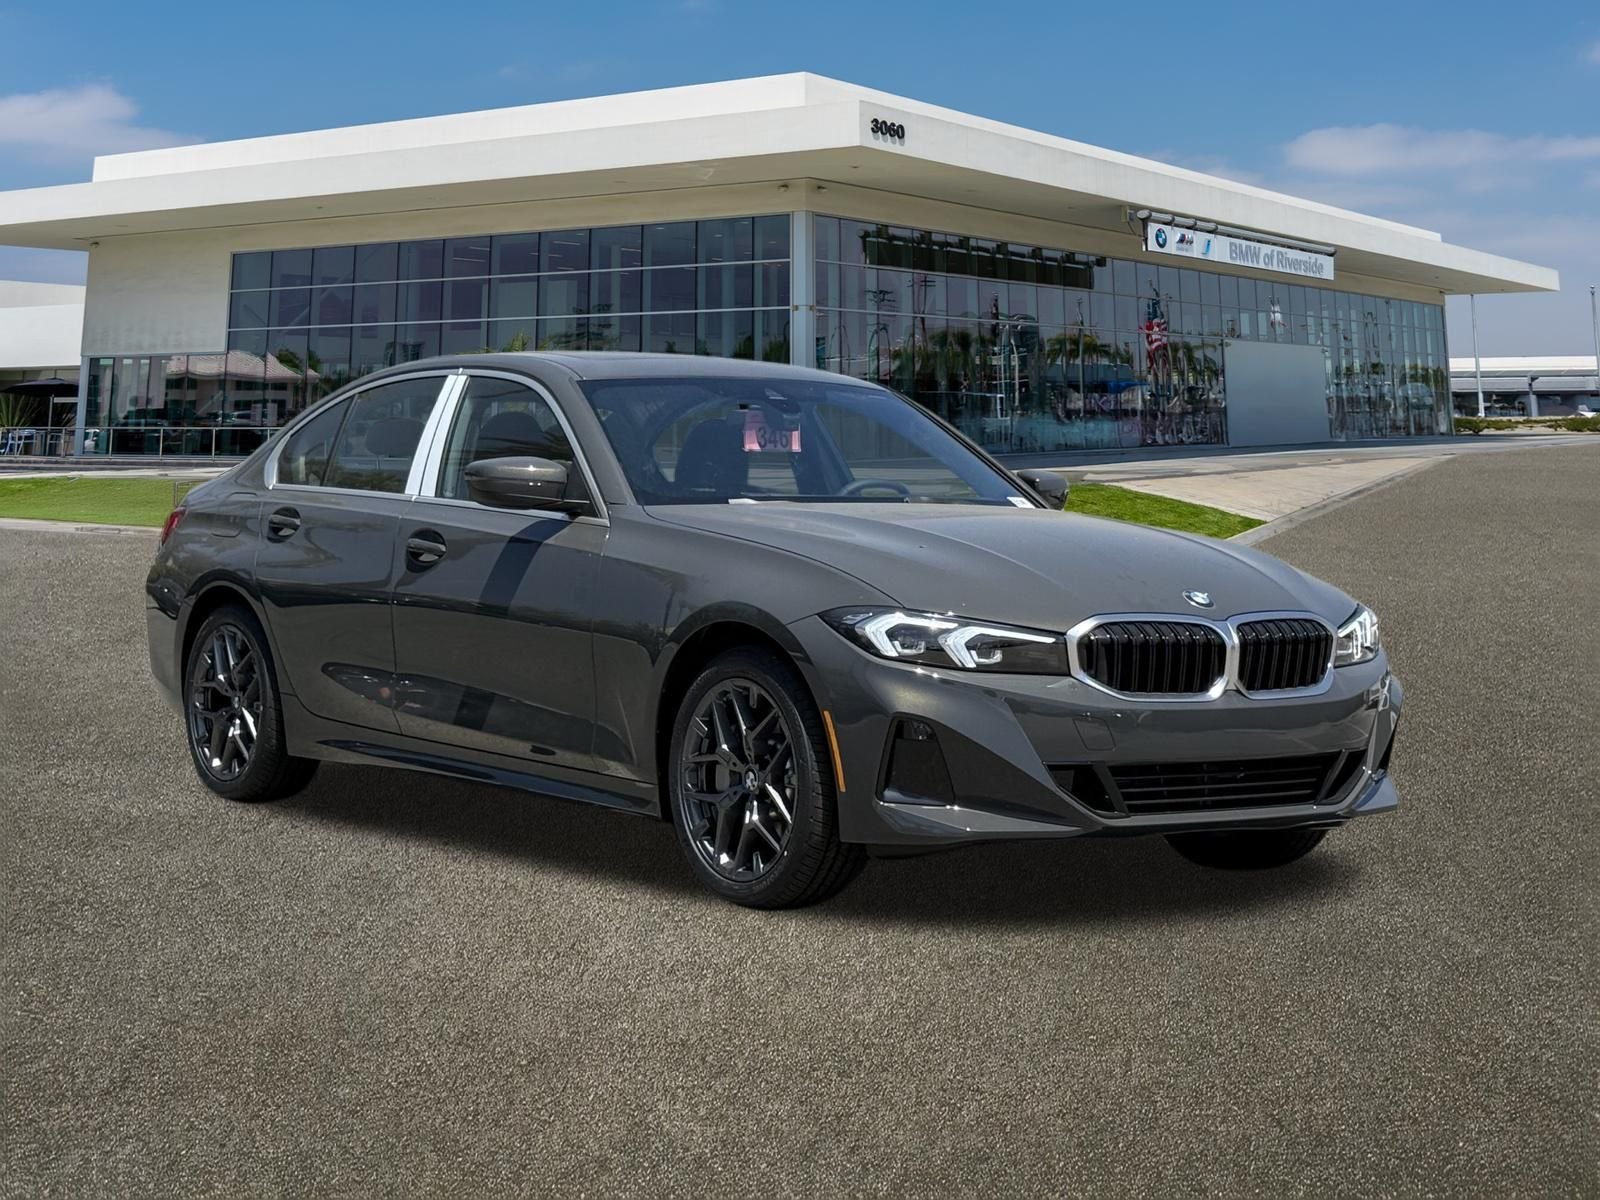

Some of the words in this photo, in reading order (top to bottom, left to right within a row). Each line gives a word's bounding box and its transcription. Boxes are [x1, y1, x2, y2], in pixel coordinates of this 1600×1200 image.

[870, 118, 905, 139] 3060
[1229, 241, 1261, 265] BMW
[1263, 249, 1275, 267] of
[1276, 250, 1324, 275] Riverside
